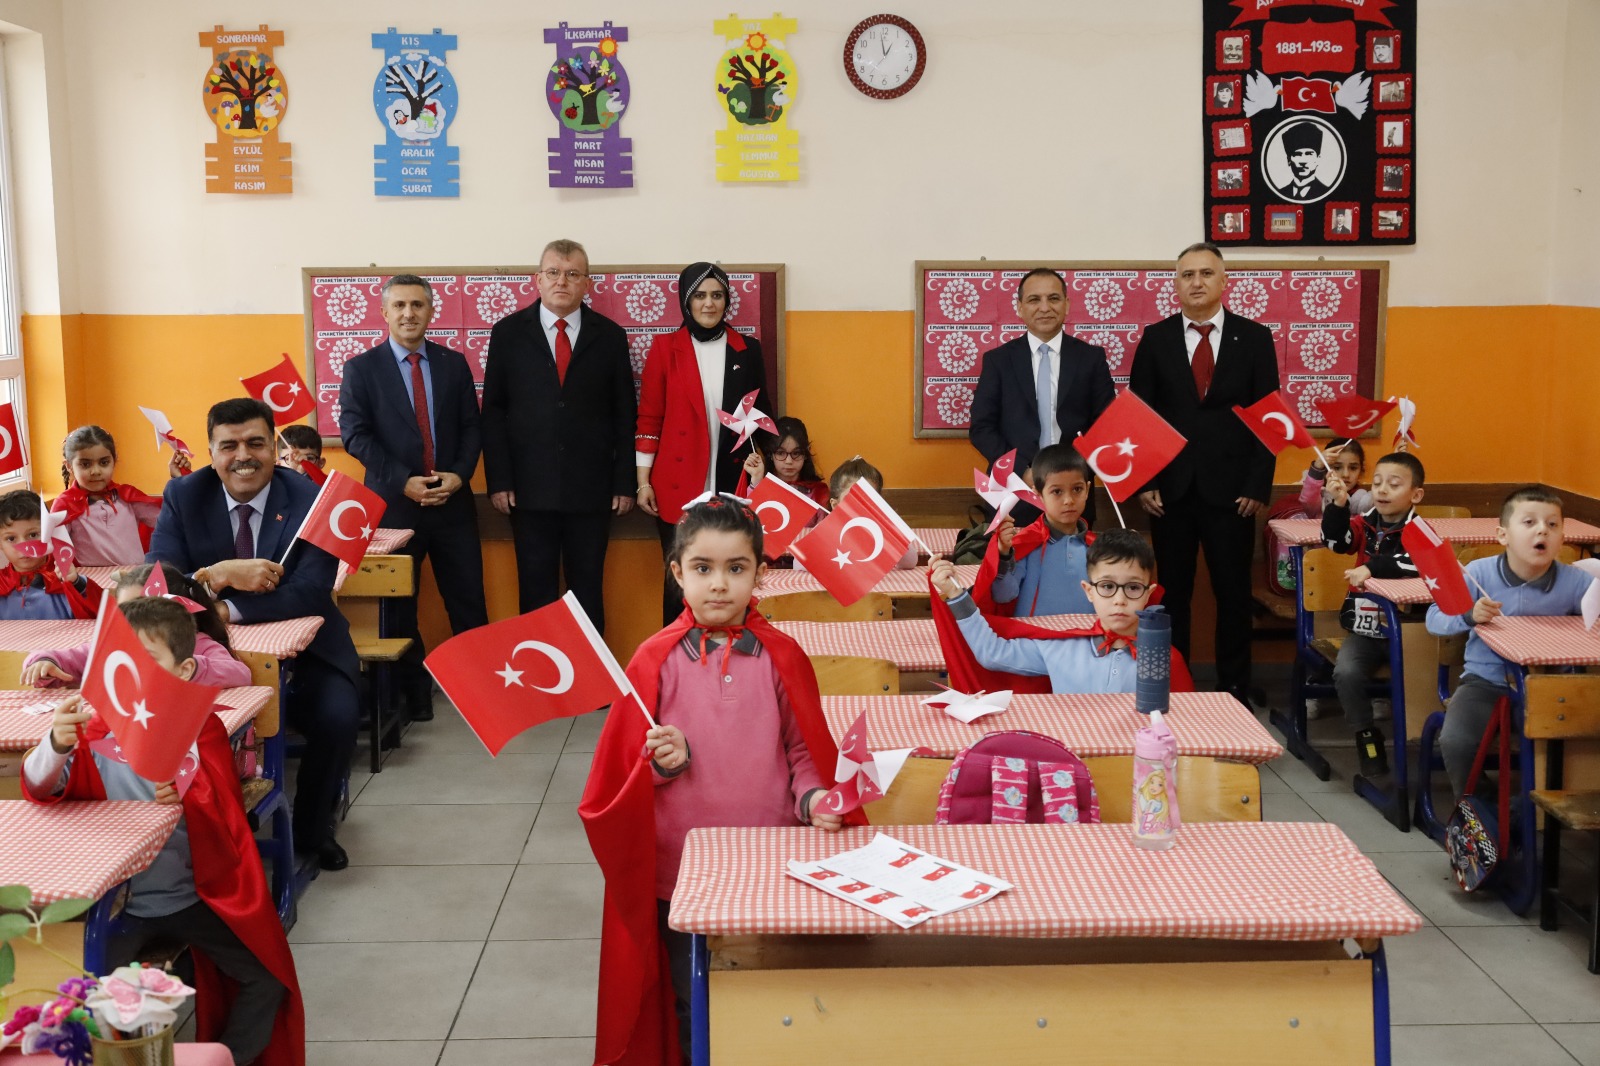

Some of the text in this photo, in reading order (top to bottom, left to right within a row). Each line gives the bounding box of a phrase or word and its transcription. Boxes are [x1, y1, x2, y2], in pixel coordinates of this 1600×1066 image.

[564, 28, 612, 40] İLKBAHAR
[869, 31, 876, 40] 11
[881, 27, 889, 35] 12
[216, 34, 268, 44] SONBAHAR
[401, 36, 420, 48] KIŞ
[860, 39, 868, 48] 10
[904, 39, 910, 48] 2
[856, 53, 862, 61] 9
[908, 53, 914, 62] 3
[233, 144, 263, 155] EYLÜL
[574, 141, 602, 150] MART
[400, 148, 435, 157] ARALIK
[574, 158, 605, 168] NİSAN
[234, 163, 260, 173] EKİM
[401, 167, 428, 176] OCAK
[574, 175, 605, 184] MAYIS
[234, 181, 266, 190] KASIM
[401, 184, 433, 195] ŞUBAT
